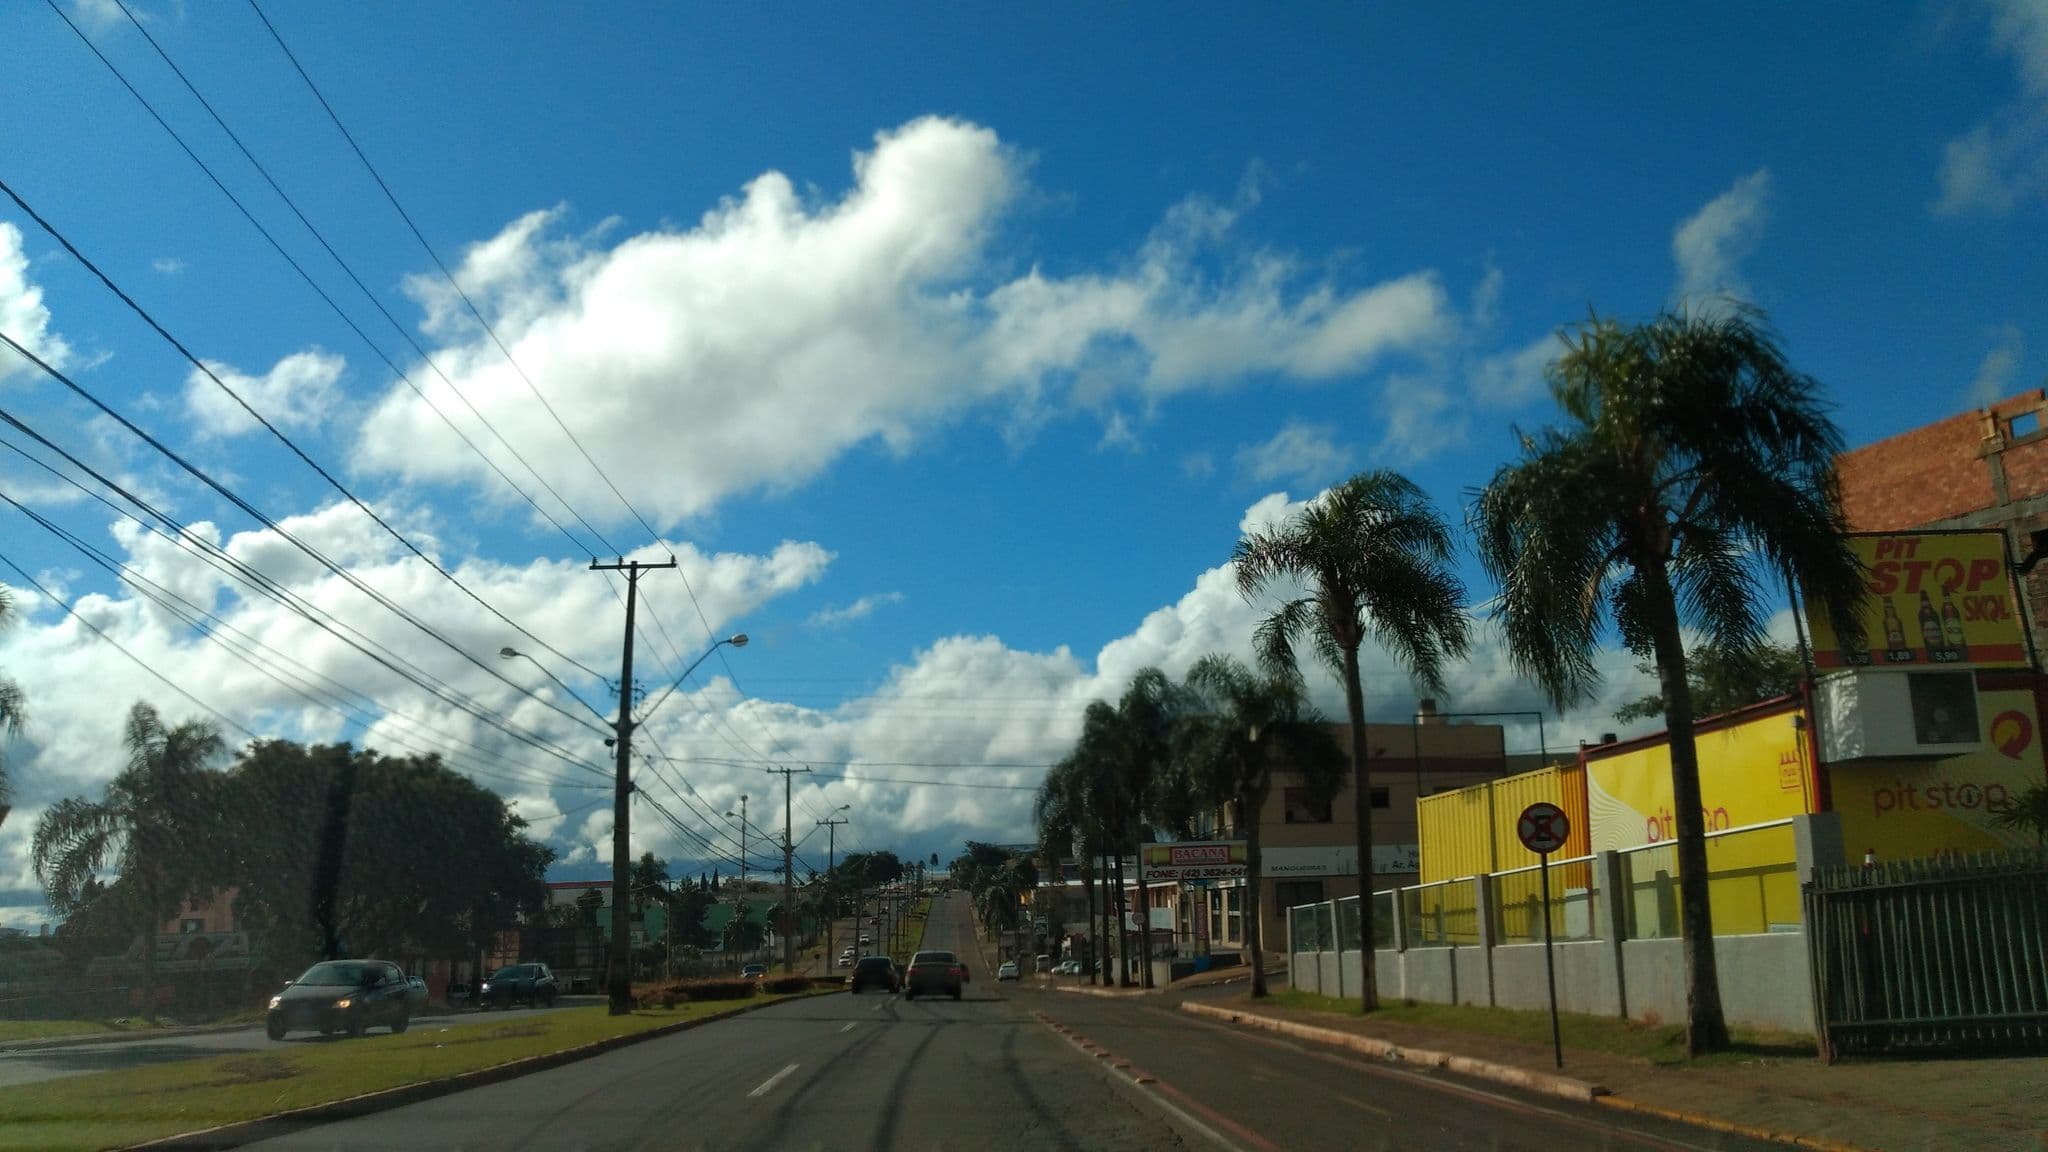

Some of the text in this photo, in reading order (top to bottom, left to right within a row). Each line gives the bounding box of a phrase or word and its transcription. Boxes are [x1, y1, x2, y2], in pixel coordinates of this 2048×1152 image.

[1874, 538, 1922, 560] PIT
[1871, 558, 2001, 595] STOP
[1962, 594, 2012, 623] SKOL
[1872, 780, 2008, 819] pit stop
[1174, 847, 1226, 859] BACANA
[1145, 869, 1179, 879] FONE:
